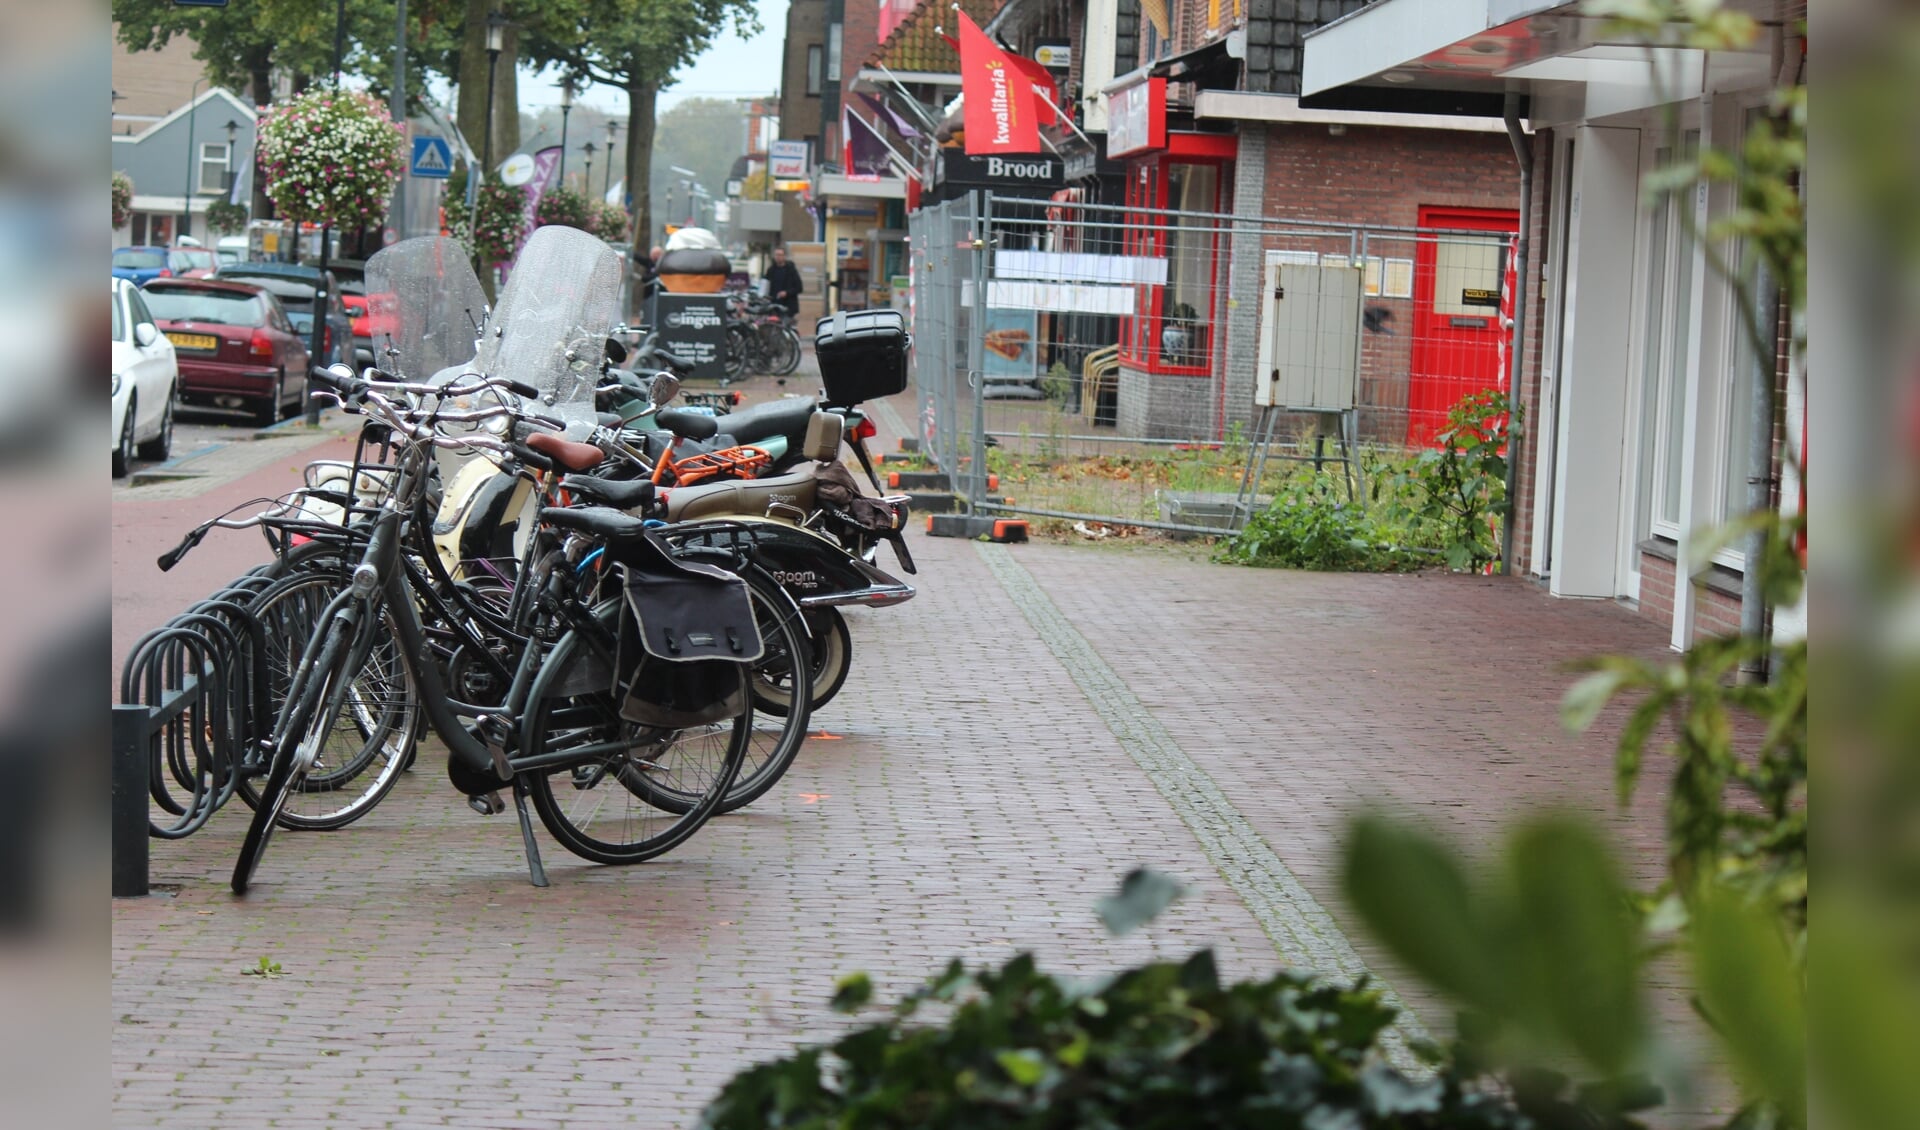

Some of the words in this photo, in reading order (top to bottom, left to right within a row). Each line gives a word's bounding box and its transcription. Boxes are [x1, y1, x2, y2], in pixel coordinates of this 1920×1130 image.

[991, 69, 1009, 144] kwalitaria
[987, 157, 1052, 178] Brood
[778, 495, 796, 503] agm
[786, 571, 815, 585] agm
